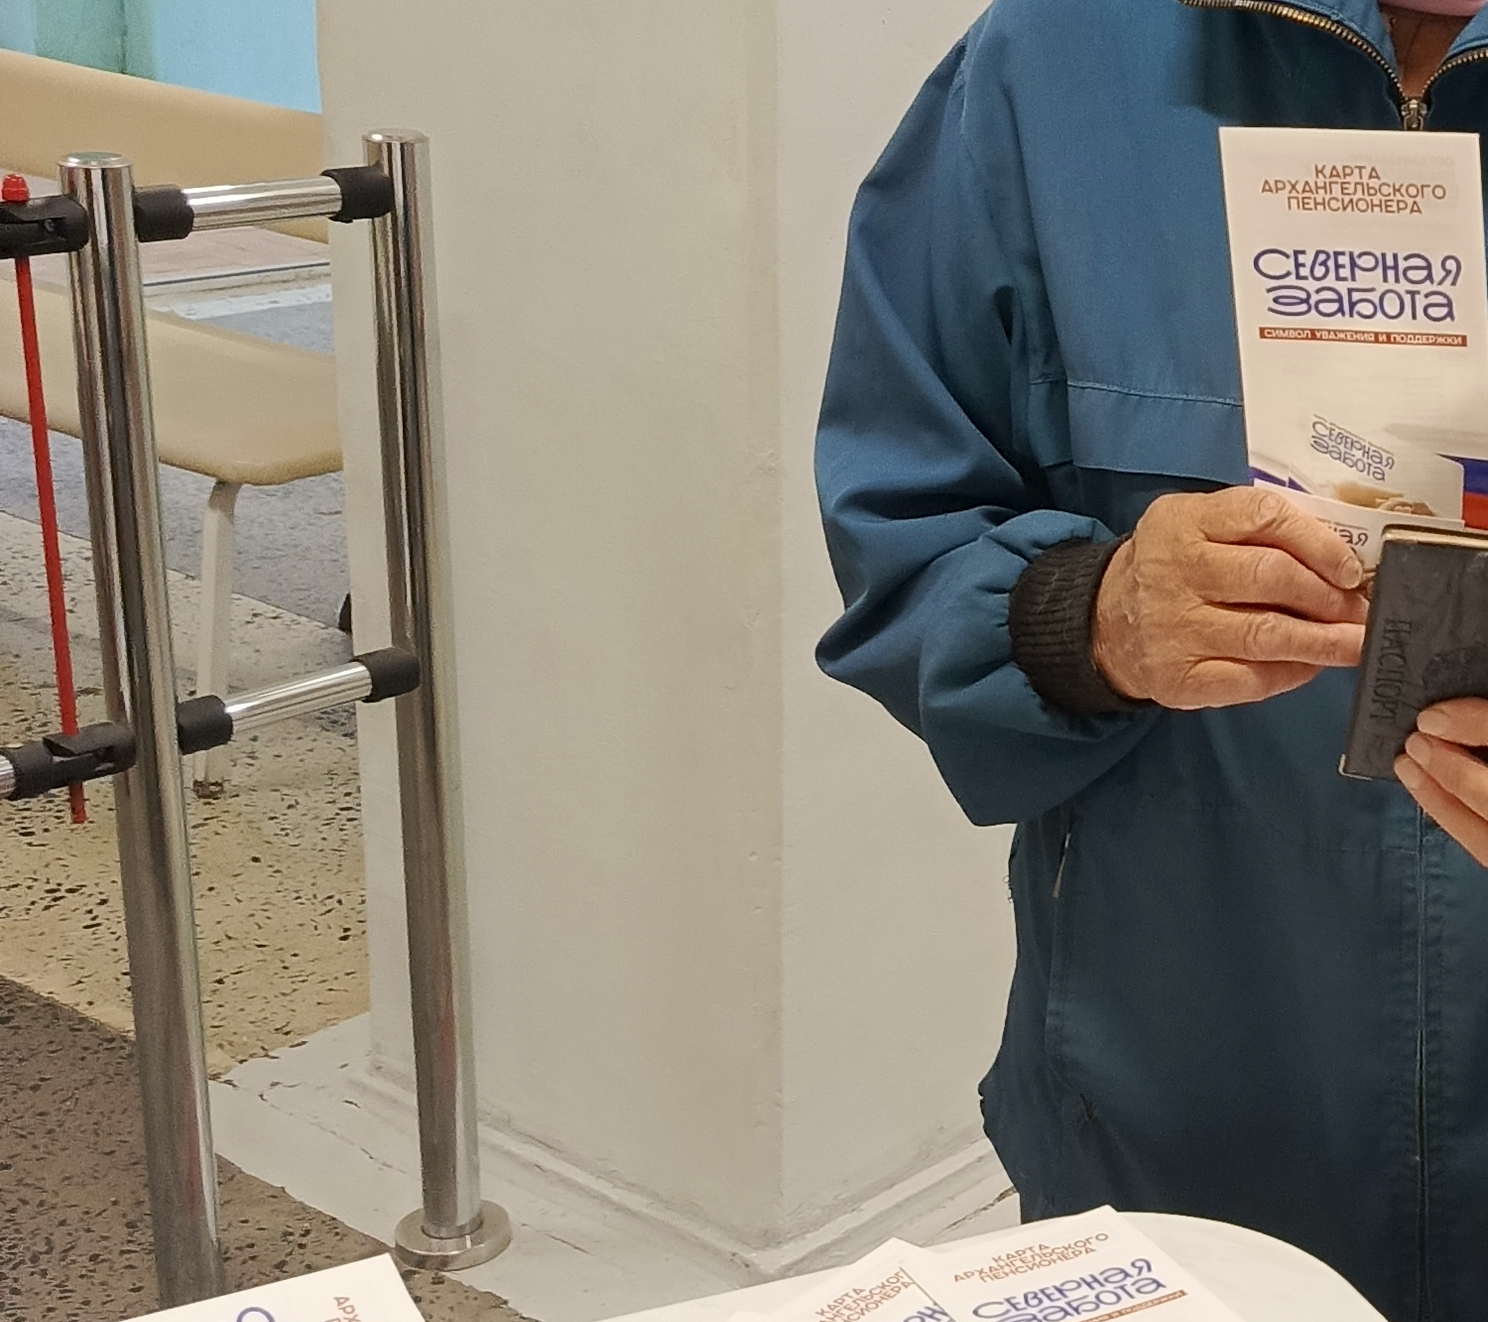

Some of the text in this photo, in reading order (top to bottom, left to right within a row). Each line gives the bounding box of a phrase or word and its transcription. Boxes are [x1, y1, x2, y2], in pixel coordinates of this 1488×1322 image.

[1315, 165, 1380, 180] КАРТА
[1261, 179, 1446, 200] АРХАНГЕЛЬСКОГО
[1287, 197, 1422, 215] ПЕНСИОНЕРА
[1253, 248, 1461, 286] СЕВЕРНАЯ
[1266, 285, 1455, 321] ЗАБОТА
[1264, 328, 1463, 346] СИМВОЛ УВАЖЕНИЯ И ПОДДЕРЖКИ
[954, 1233, 1109, 1282] АРХАНГЕЛЬСКОГО
[980, 1247, 1096, 1283] ПЕНСИОНЕРА
[992, 1244, 1050, 1264] КАРТА
[815, 1287, 866, 1317] КАРТА
[972, 1258, 1152, 1319] СЕВЕРНАЯ
